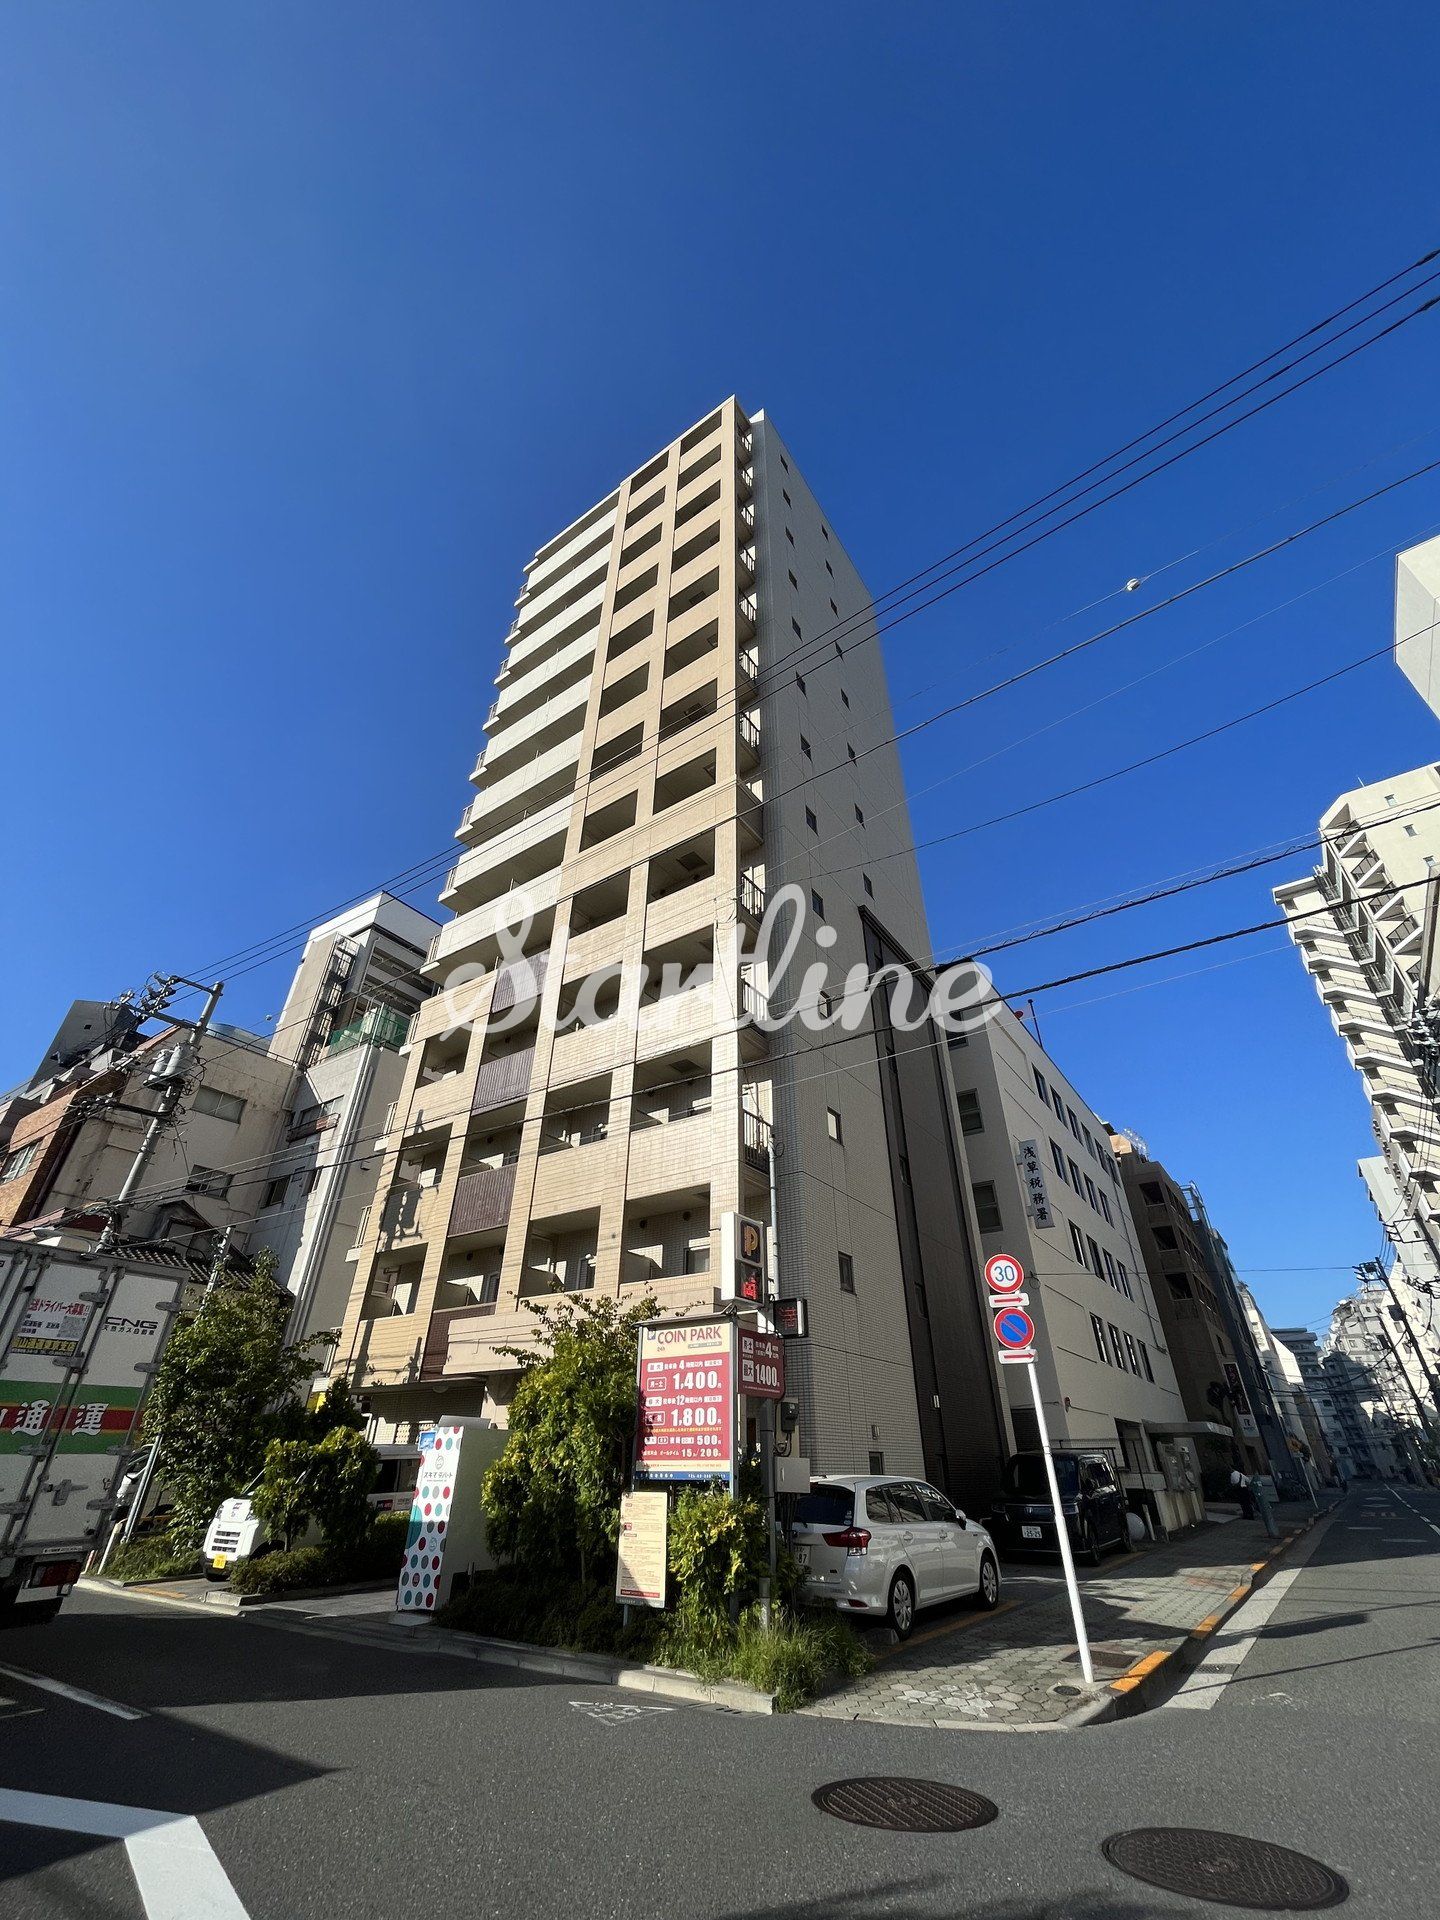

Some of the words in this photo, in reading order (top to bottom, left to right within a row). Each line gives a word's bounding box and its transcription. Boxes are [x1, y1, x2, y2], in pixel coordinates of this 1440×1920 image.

[1024, 1147, 1048, 1220] 浅草税務署
[744, 1226, 758, 1256] P
[994, 1265, 1015, 1283] 30
[102, 1325, 155, 1336] 天然ガス自動車
[104, 1316, 159, 1330] CNG
[658, 1329, 687, 1344] COIN
[690, 1325, 722, 1341] PARK
